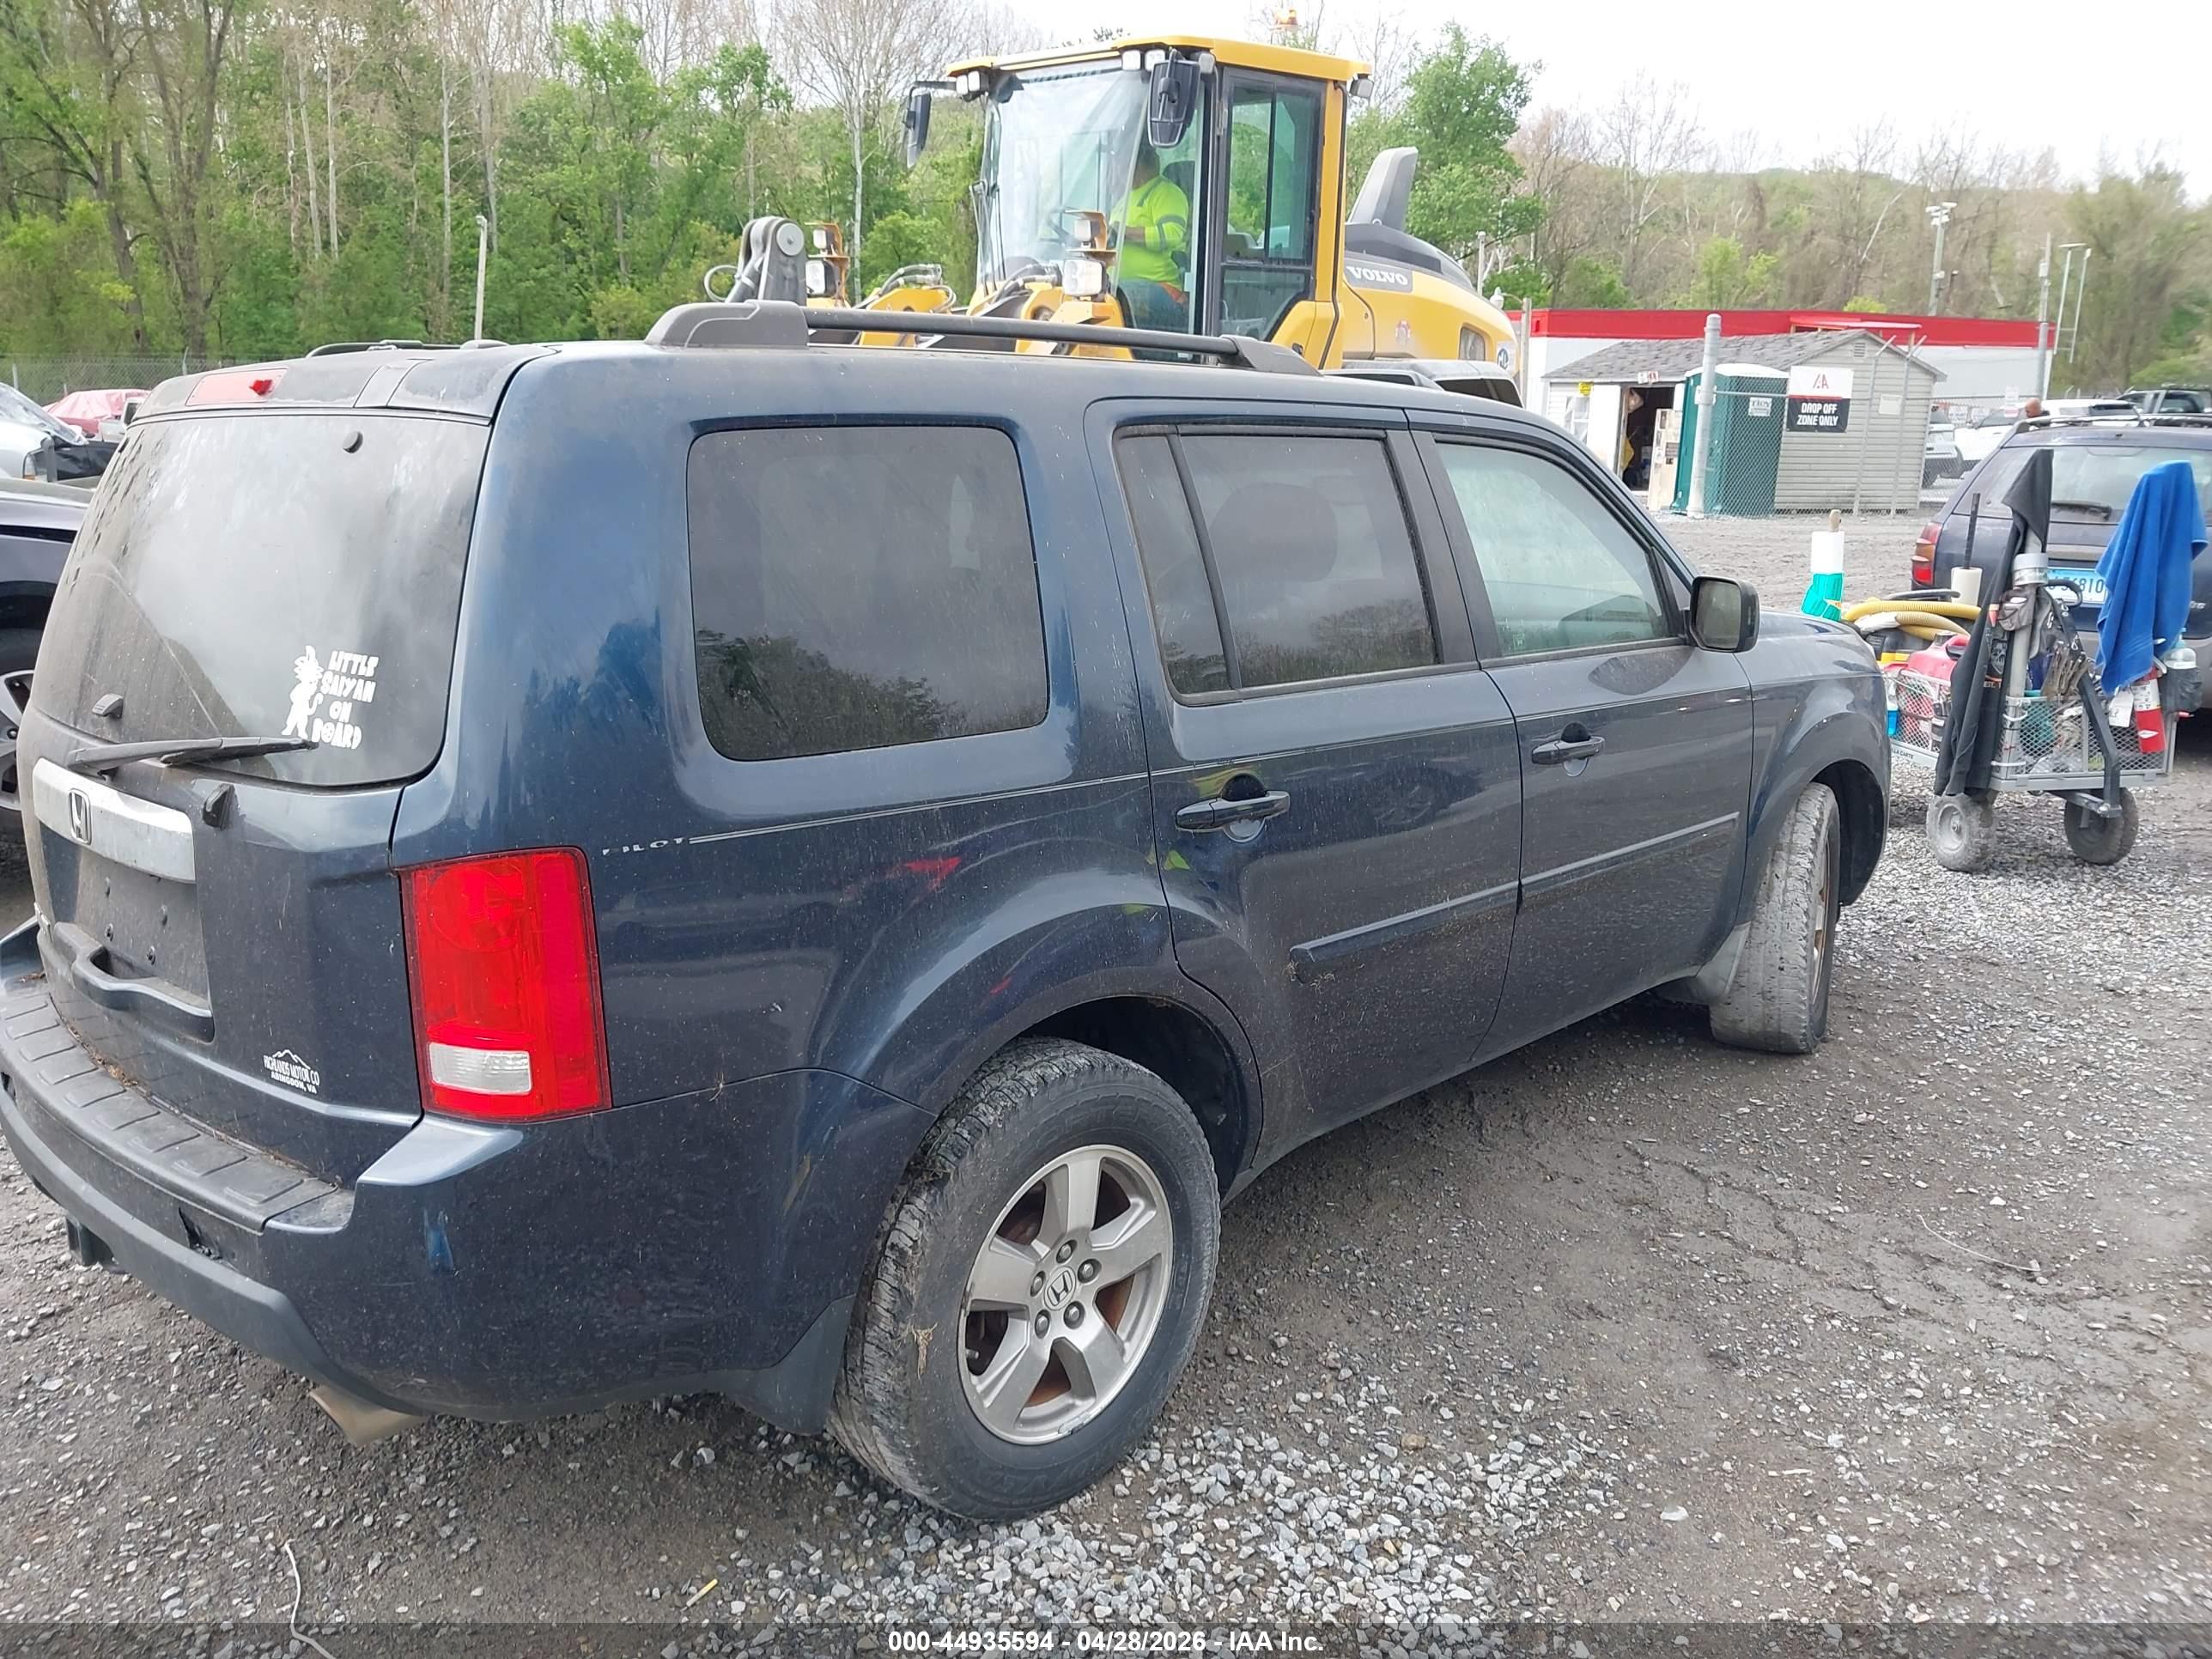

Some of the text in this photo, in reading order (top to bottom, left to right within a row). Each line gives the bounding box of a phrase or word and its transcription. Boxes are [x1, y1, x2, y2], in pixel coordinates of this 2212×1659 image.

[1346, 265, 1408, 285] VOLVO
[1801, 402, 1838, 415] DROP OFF
[1796, 414, 1838, 427] ZONE ONLY
[328, 650, 380, 678] LITTLE
[320, 670, 377, 703] SAIYAN
[329, 700, 353, 723] ON
[311, 717, 362, 750] BOARD
[289, 1063, 311, 1083] MOTOR
[310, 1070, 320, 1086] CO
[306, 1083, 318, 1094] VA
